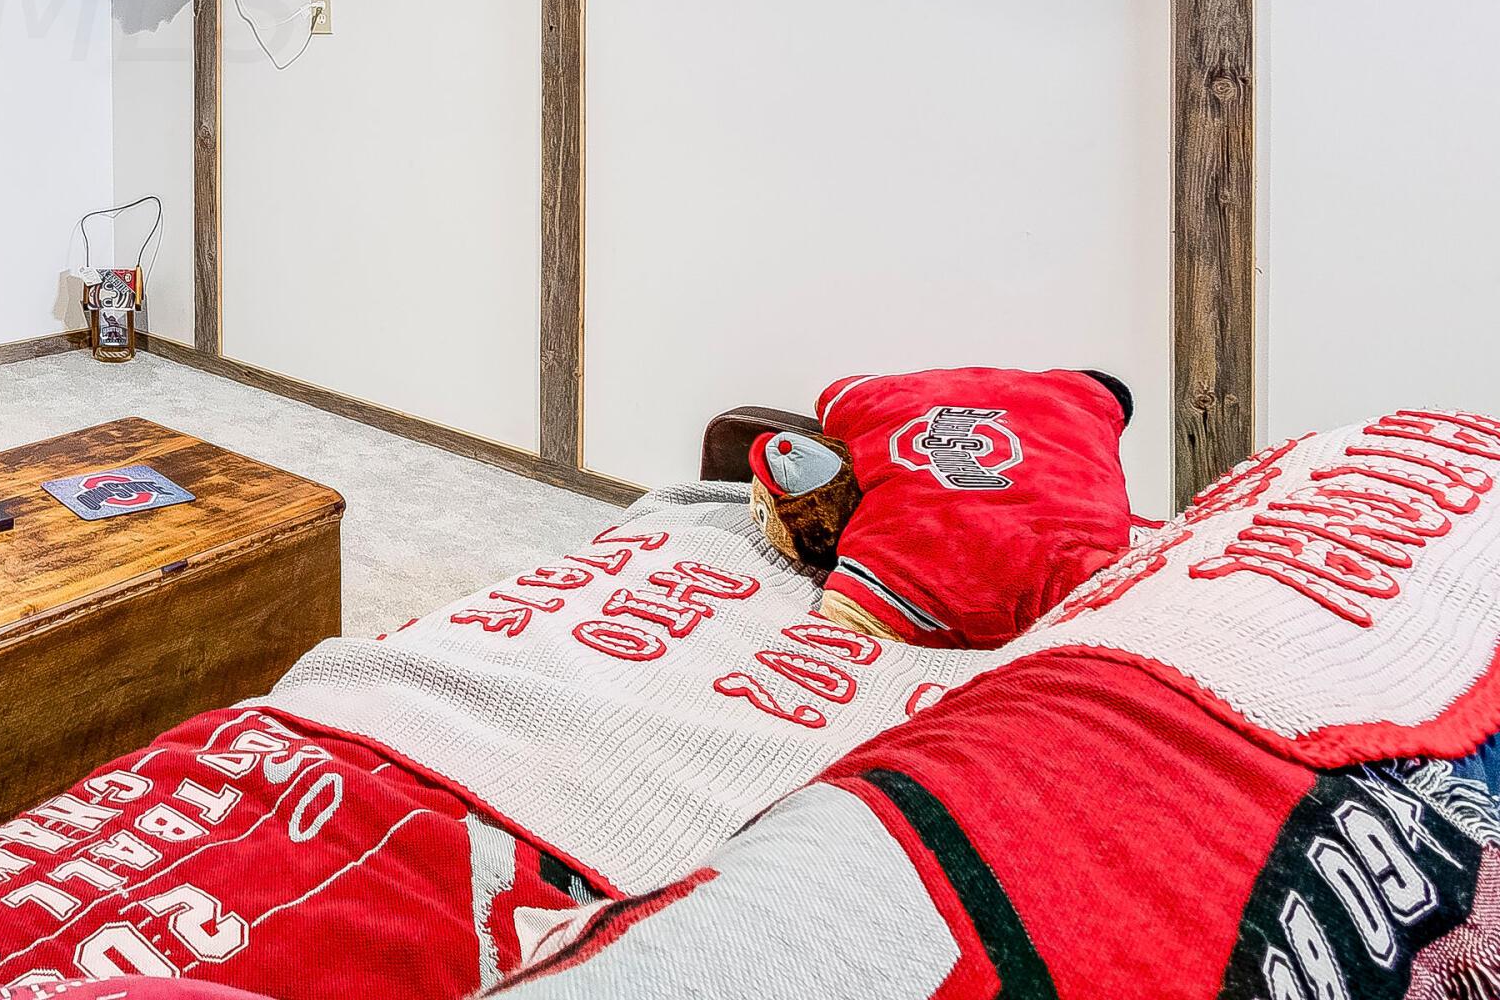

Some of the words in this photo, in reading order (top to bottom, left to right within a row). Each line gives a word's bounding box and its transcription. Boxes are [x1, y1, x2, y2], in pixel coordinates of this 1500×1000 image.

[450, 526, 670, 638] STATE
[571, 560, 761, 661] OHIO
[713, 612, 883, 728] 002
[1306, 799, 1440, 970] GO
